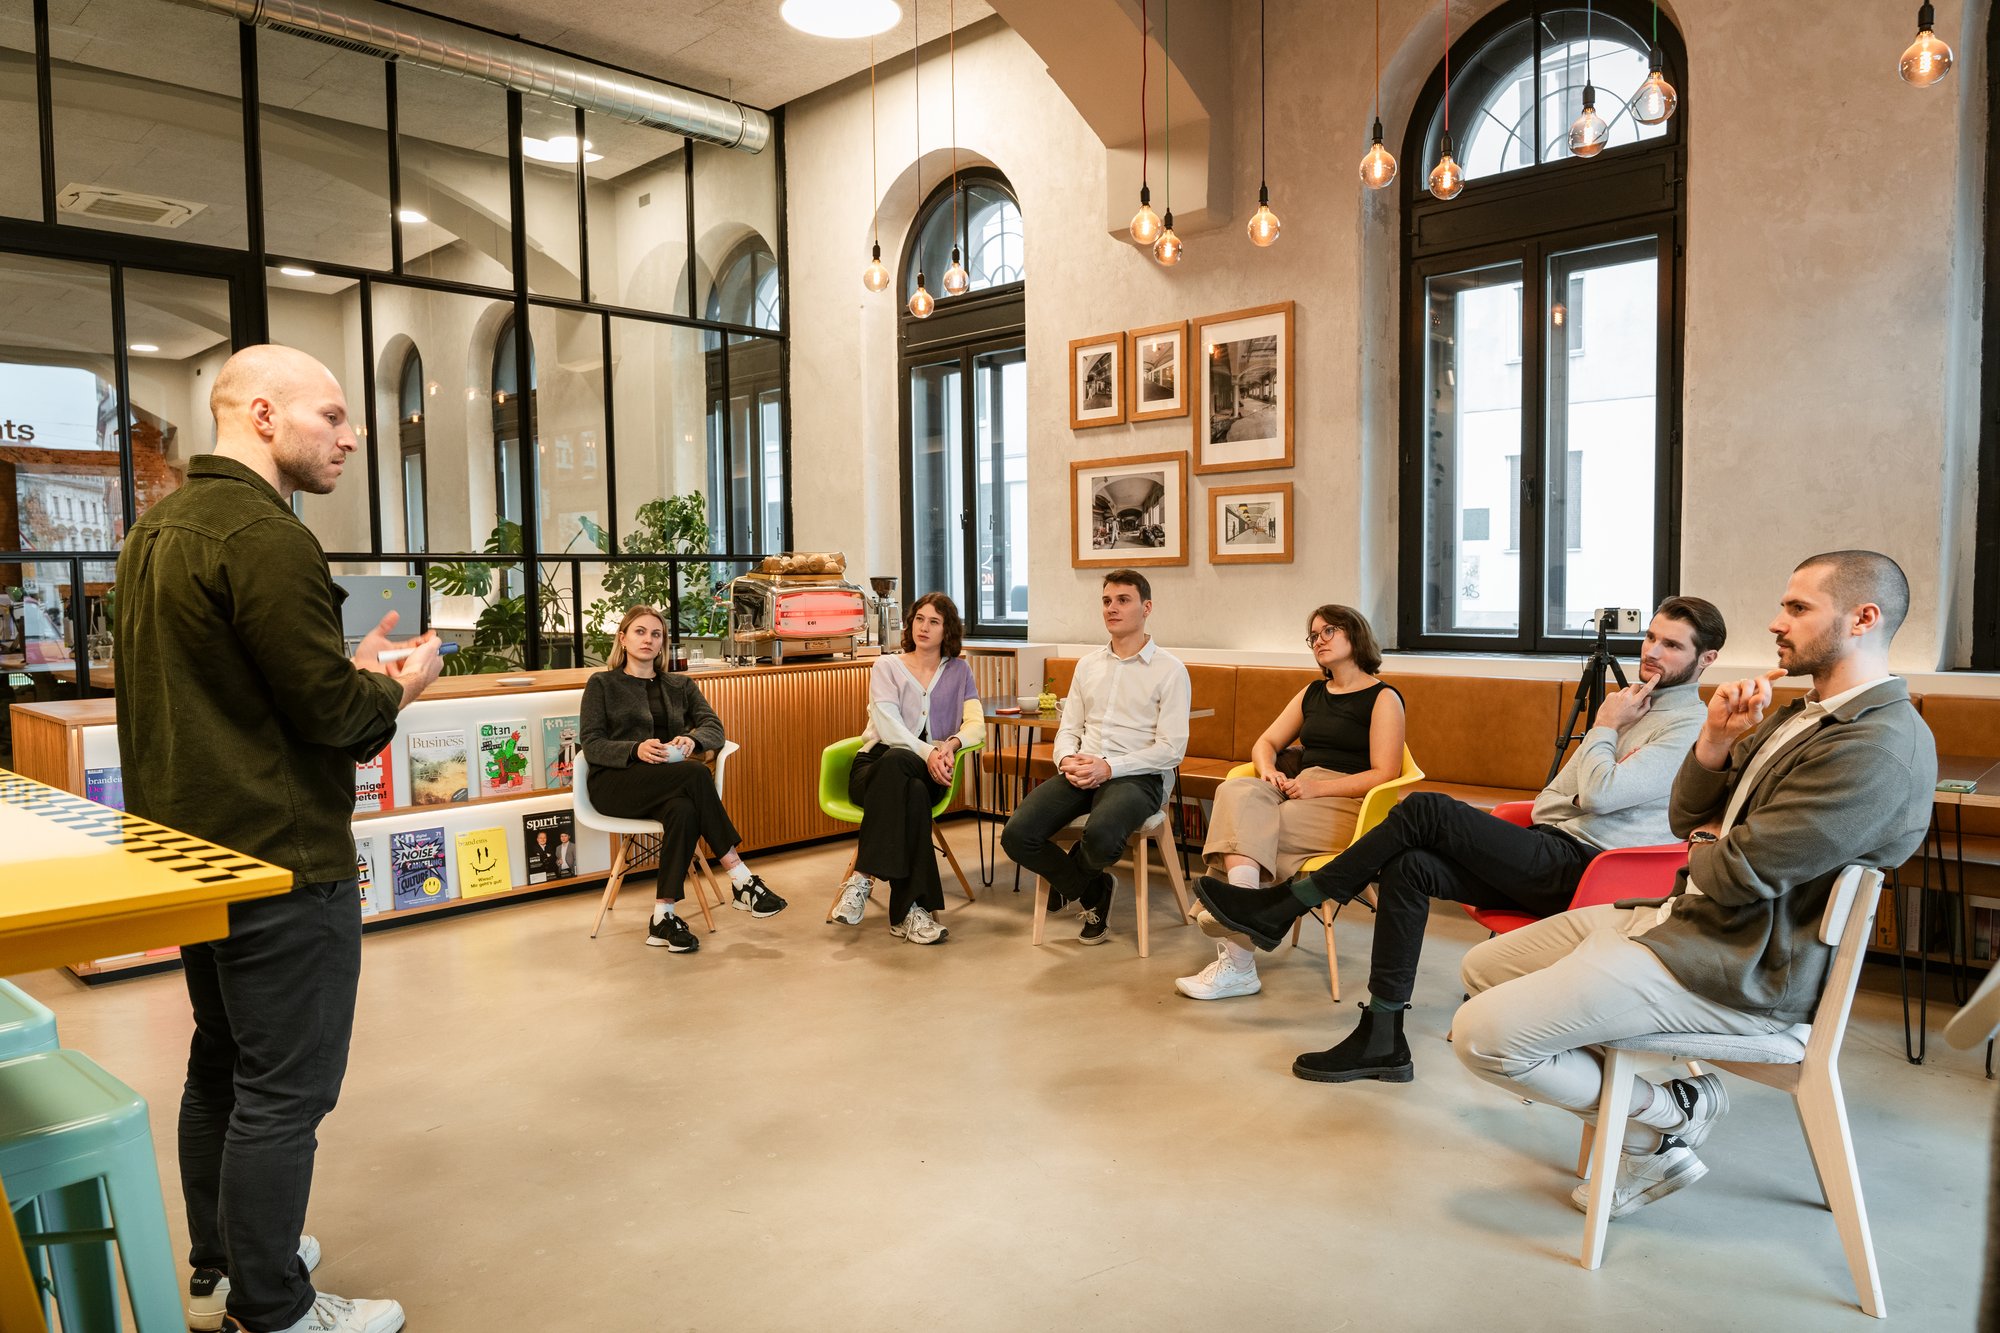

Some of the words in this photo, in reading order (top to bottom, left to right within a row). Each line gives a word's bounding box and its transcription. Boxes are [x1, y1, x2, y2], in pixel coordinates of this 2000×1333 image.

[0, 419, 35, 441] ts
[412, 736, 465, 749] Business
[88, 776, 112, 784] brand
[354, 781, 386, 792] eniger
[354, 790, 387, 801] eiten!
[401, 848, 434, 861] NOISE
[401, 871, 428, 890] CULTURE
[1677, 1083, 1690, 1108] Reebok
